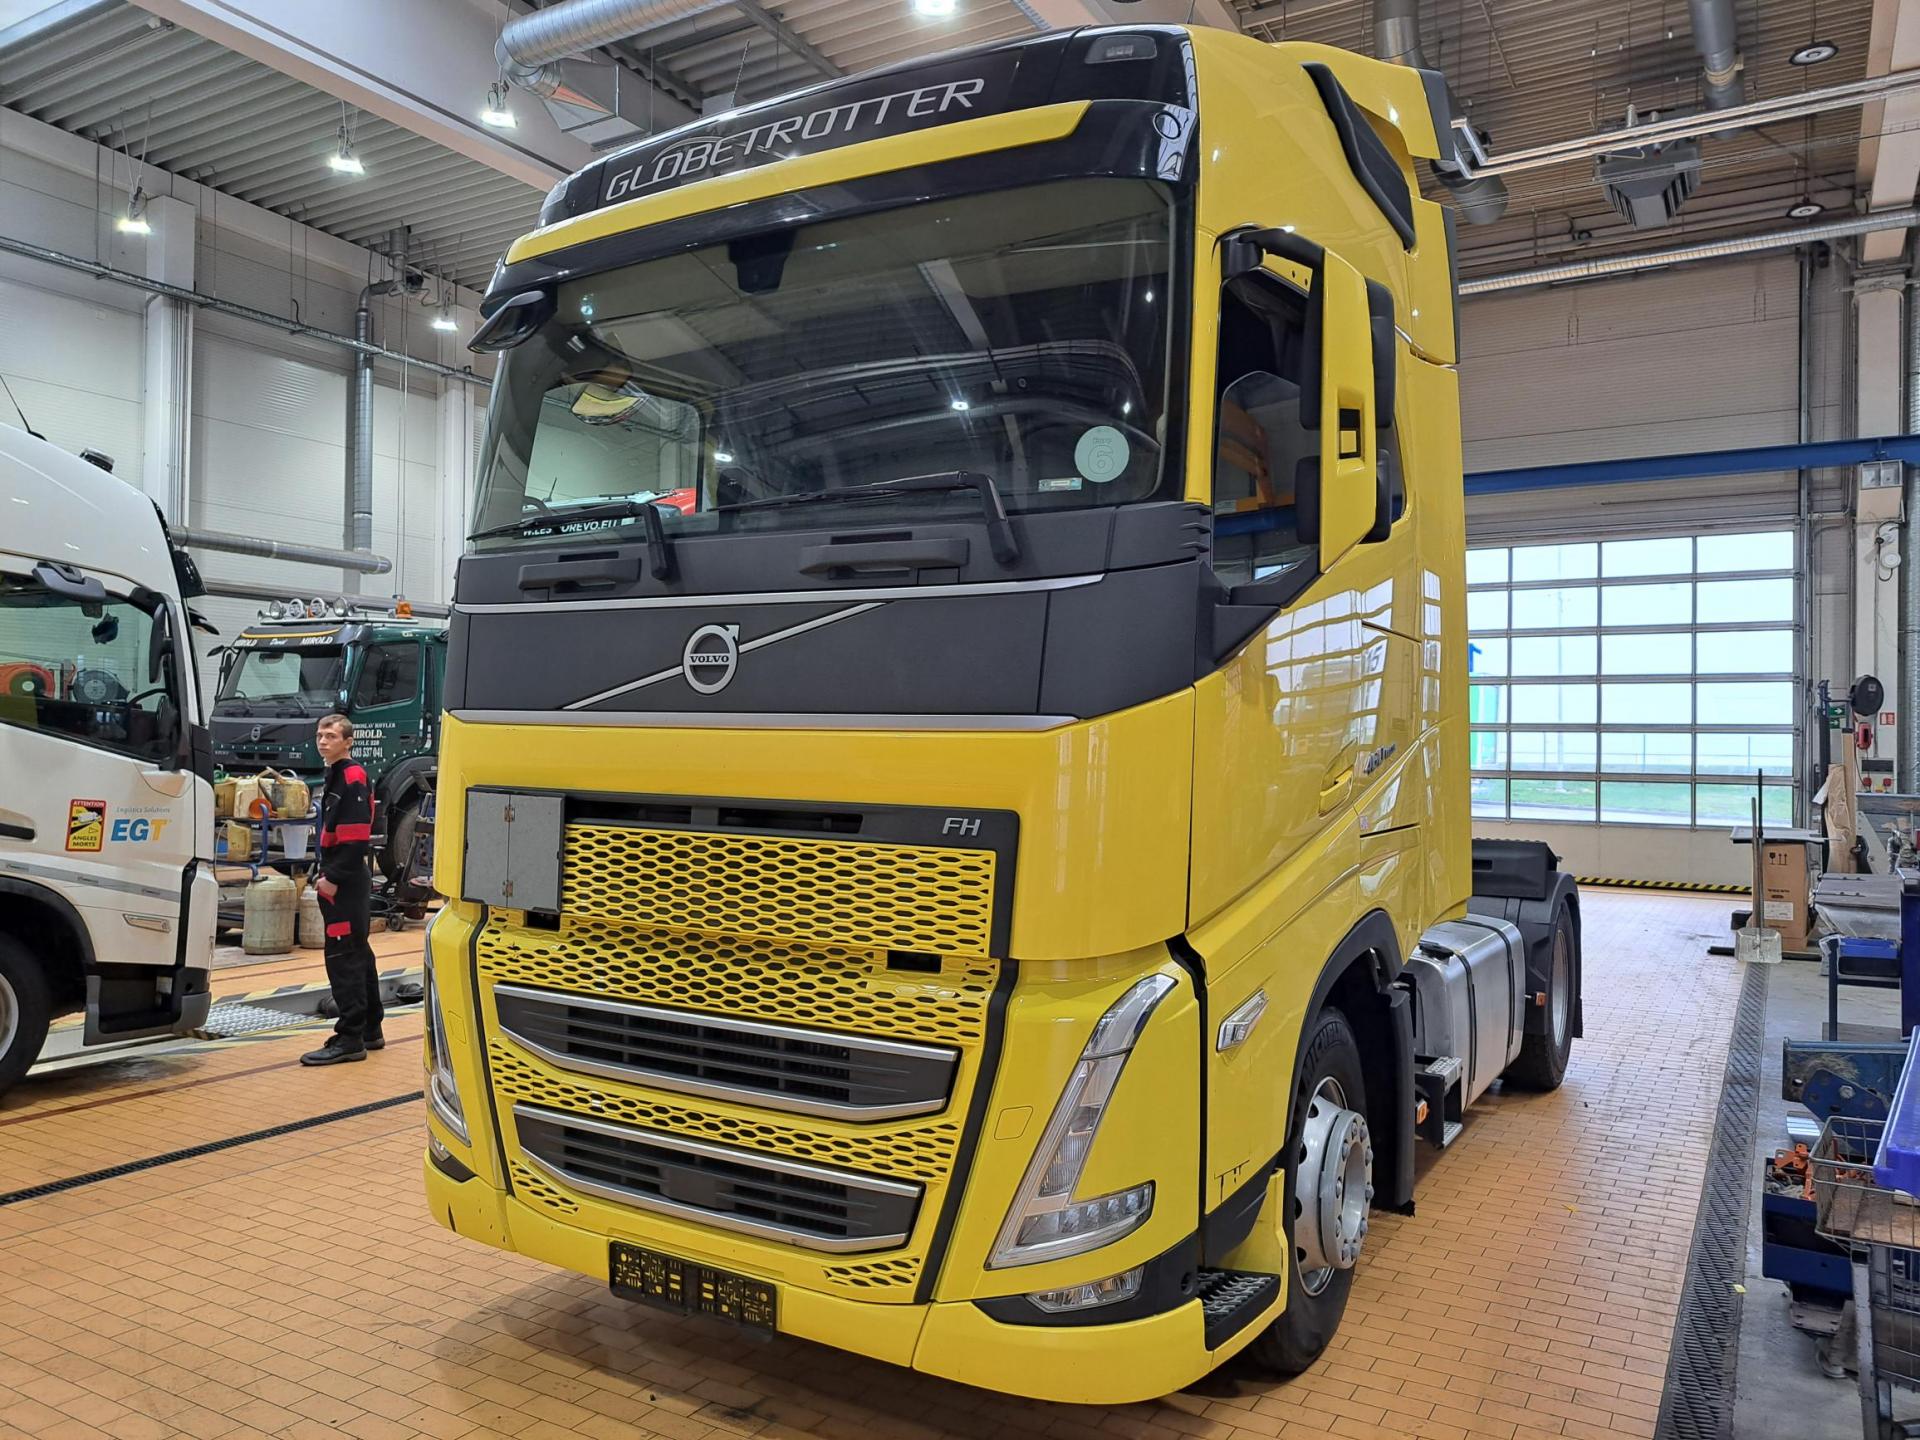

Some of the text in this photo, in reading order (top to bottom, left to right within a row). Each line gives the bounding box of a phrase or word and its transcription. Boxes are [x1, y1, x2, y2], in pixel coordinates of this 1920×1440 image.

[606, 78, 985, 202] GLOBETROTTER
[690, 655, 730, 664] VOLVO
[73, 800, 105, 808] ATTENTION
[111, 818, 168, 842] EGT
[942, 817, 981, 837] FH
